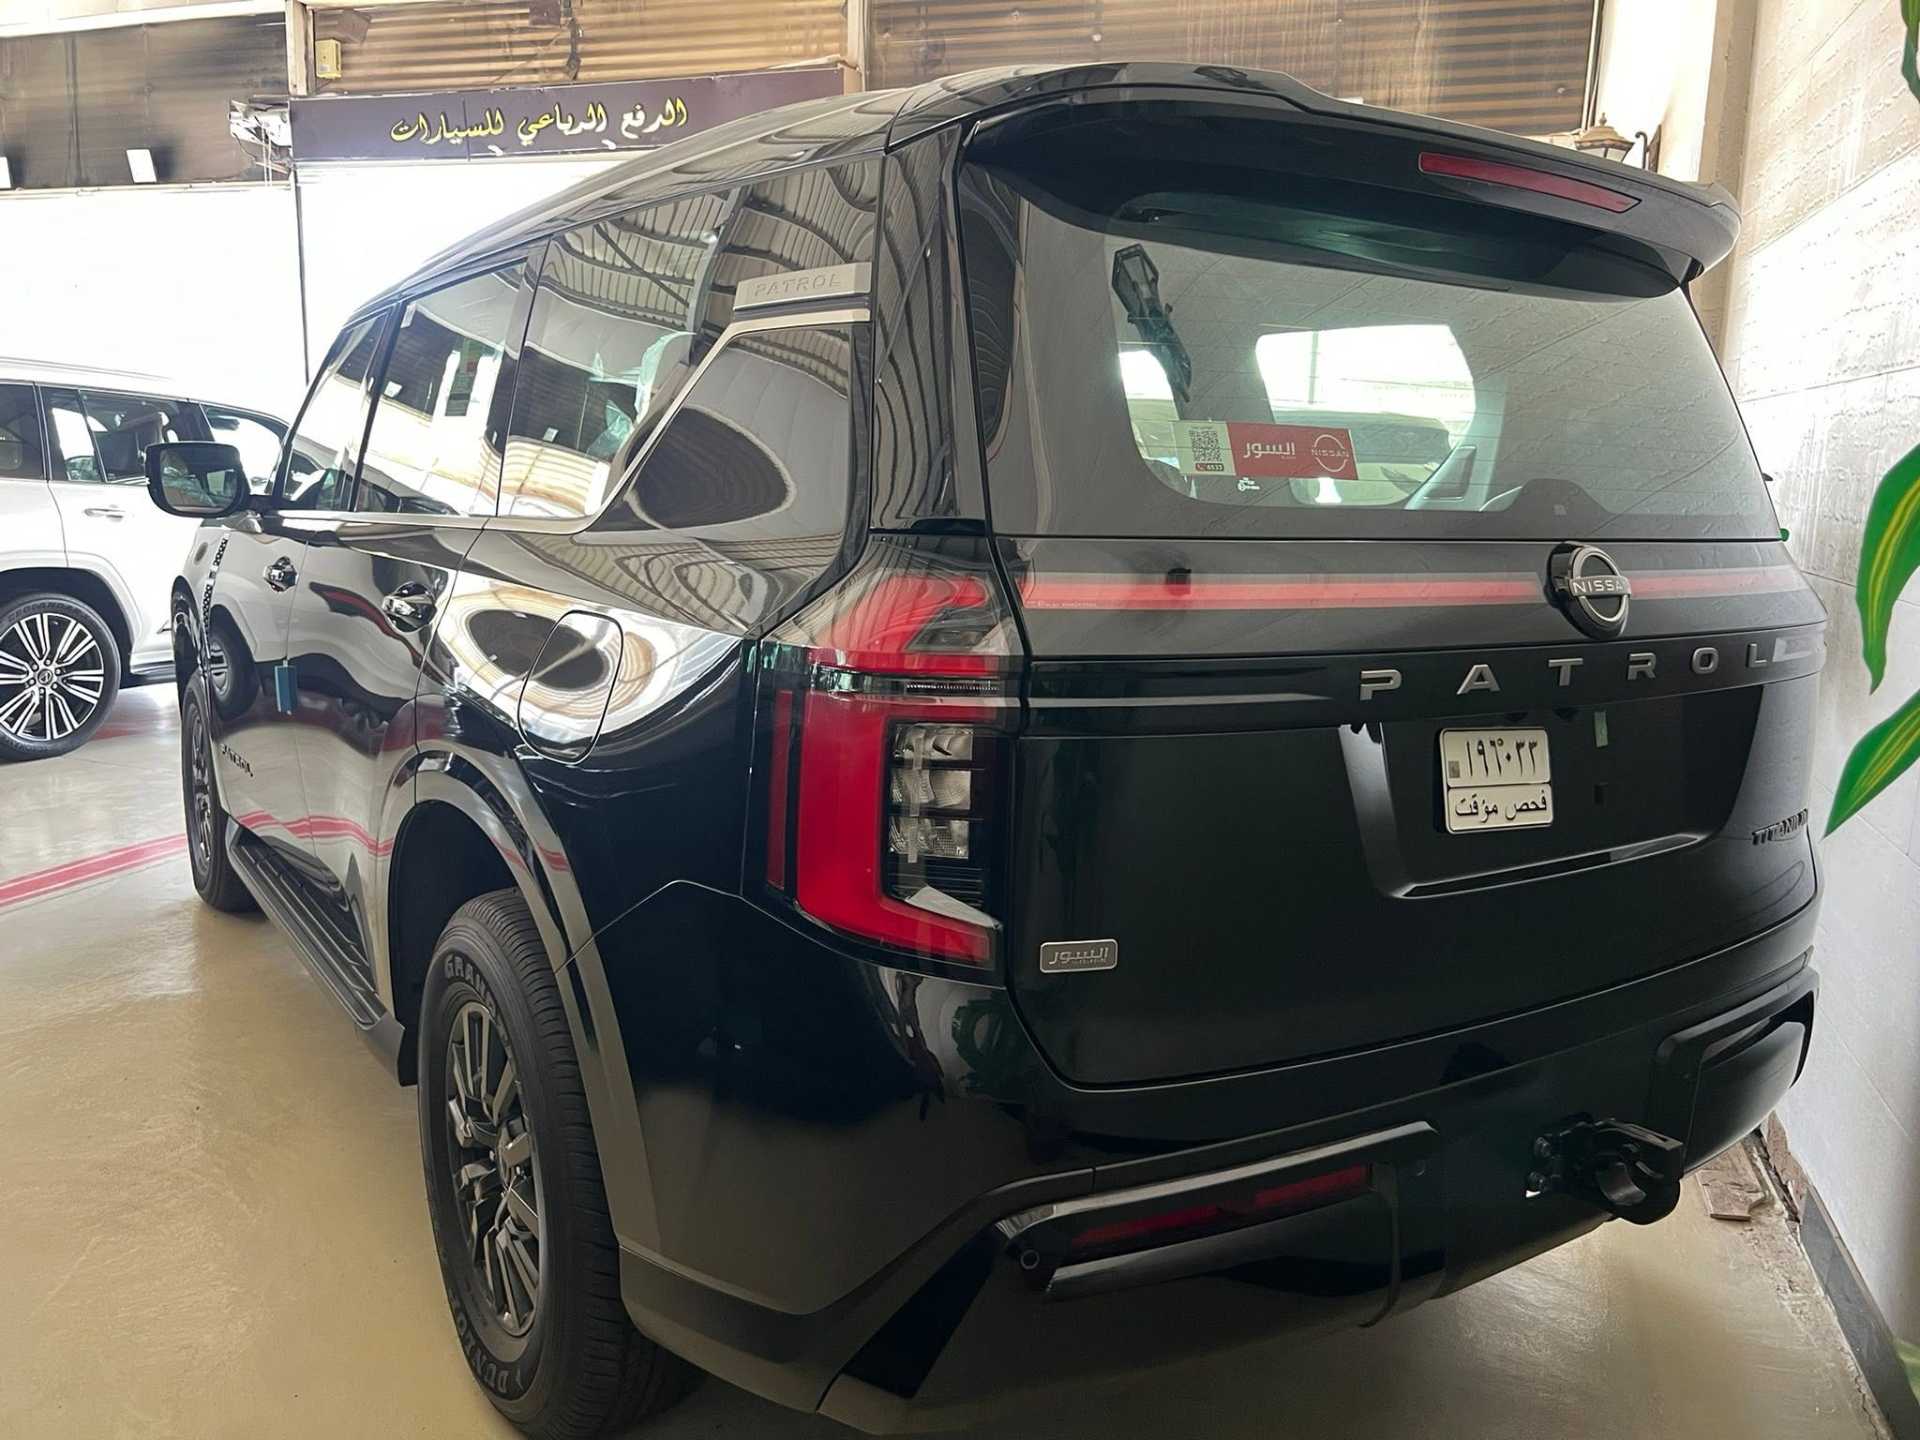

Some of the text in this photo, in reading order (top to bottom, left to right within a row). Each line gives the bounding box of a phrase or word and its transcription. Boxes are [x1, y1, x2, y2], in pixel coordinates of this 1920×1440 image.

[390, 97, 688, 147] الدفع الرباعي للسيارات
[755, 273, 841, 297] PATROL
[1243, 441, 1297, 459] السور
[1311, 448, 1350, 458] NISSAN
[1359, 642, 1768, 701] PATROL
[1455, 790, 1547, 823] فحص مؤقت
[1048, 946, 1109, 965] السور
